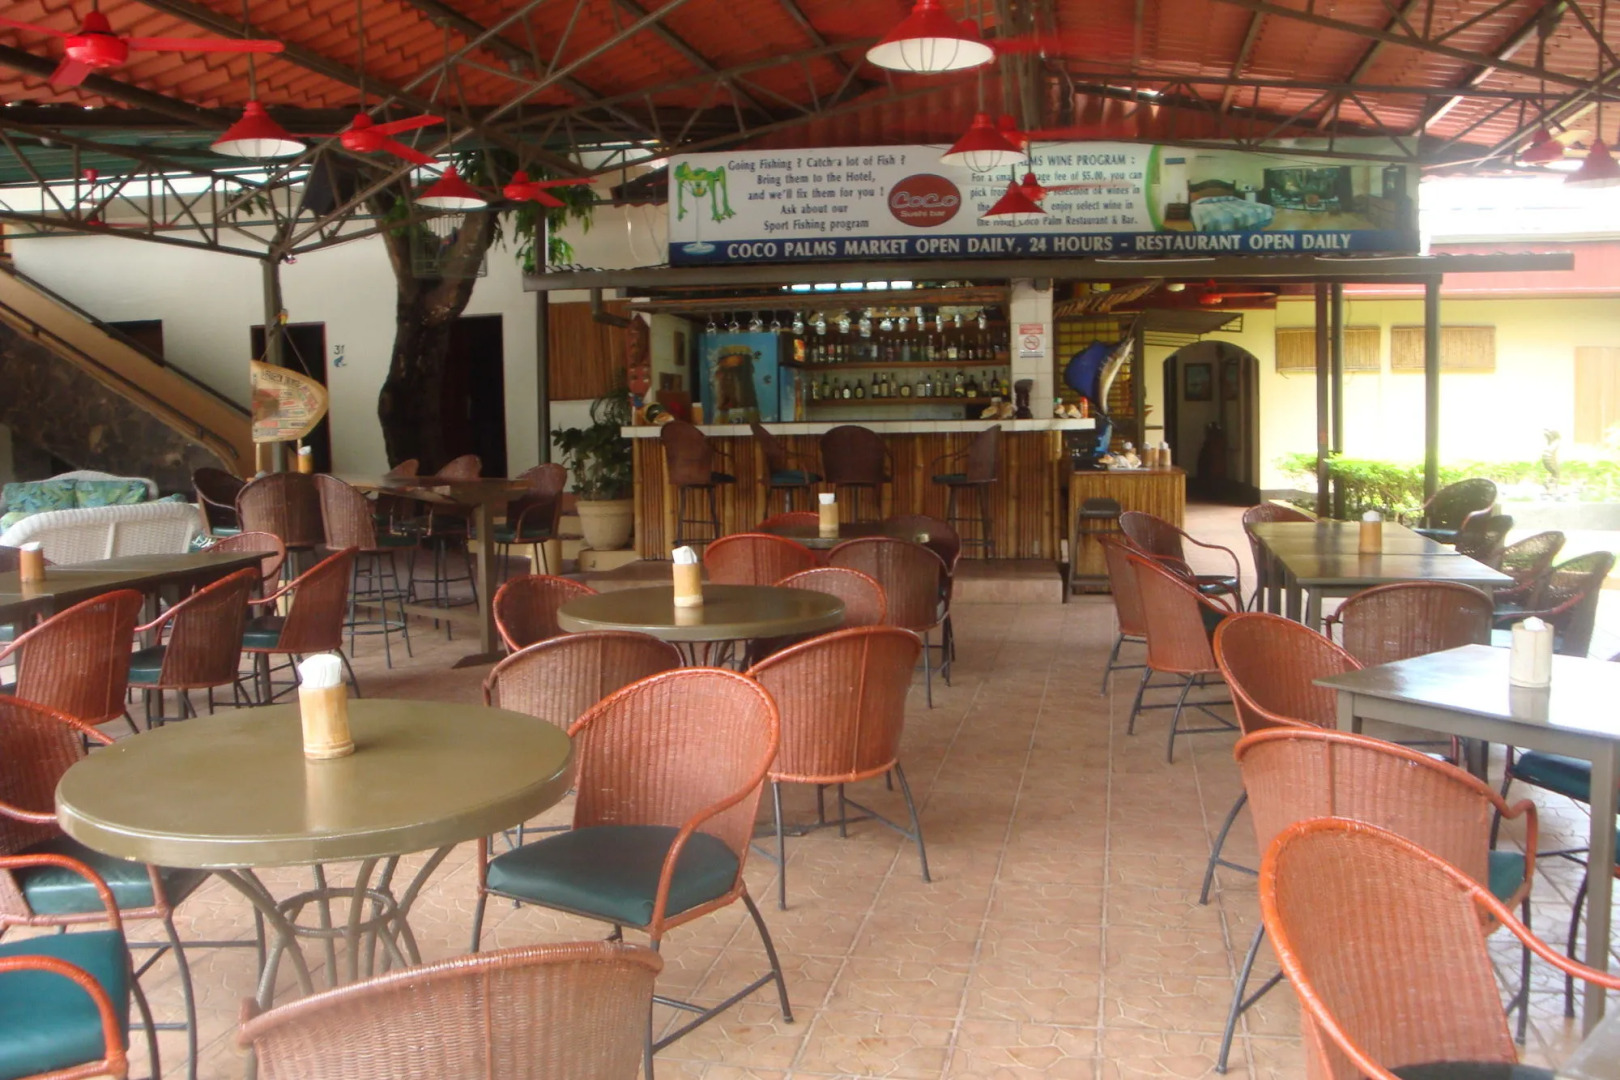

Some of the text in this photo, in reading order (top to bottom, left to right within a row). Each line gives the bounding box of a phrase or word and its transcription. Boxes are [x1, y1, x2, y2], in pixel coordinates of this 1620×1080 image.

[728, 160, 756, 172] Going
[760, 158, 792, 171] Fishing
[807, 157, 832, 168] Catch
[837, 158, 842, 166] a
[846, 156, 859, 166] lot
[863, 156, 874, 166] of
[877, 155, 895, 165] Fish
[1047, 155, 1072, 166] WINE
[1077, 154, 1126, 165] PROGRAM
[757, 171, 876, 186] Bring them to the Hotel,
[971, 173, 984, 182] For
[1055, 171, 1067, 180] fee
[1110, 172, 1125, 182] you
[1129, 172, 1143, 180] can
[748, 190, 765, 200] and
[769, 189, 792, 199] we'll
[796, 188, 807, 199] fix
[812, 188, 836, 198] them
[840, 187, 853, 197] for
[857, 189, 875, 199] you
[970, 188, 986, 200] pick
[780, 204, 848, 215] Ask about our
[1051, 202, 1072, 213] enjoy
[1077, 201, 1100, 210] select
[1103, 201, 1121, 209] wine
[763, 219, 869, 233] Sport Fishing program
[1066, 215, 1108, 225] Restaurant
[727, 242, 778, 259] COCO
[784, 240, 837, 257] PALMS
[844, 239, 908, 255] MARKET
[915, 238, 960, 254] OPEN
[967, 237, 1022, 254] DAILY,
[1029, 237, 1047, 252] 24
[1053, 236, 1113, 251] HOURS
[1135, 234, 1241, 250] RESTAURANT
[1249, 234, 1295, 250] OPEN
[1302, 233, 1351, 249] DAILY
[334, 344, 345, 355] 31
